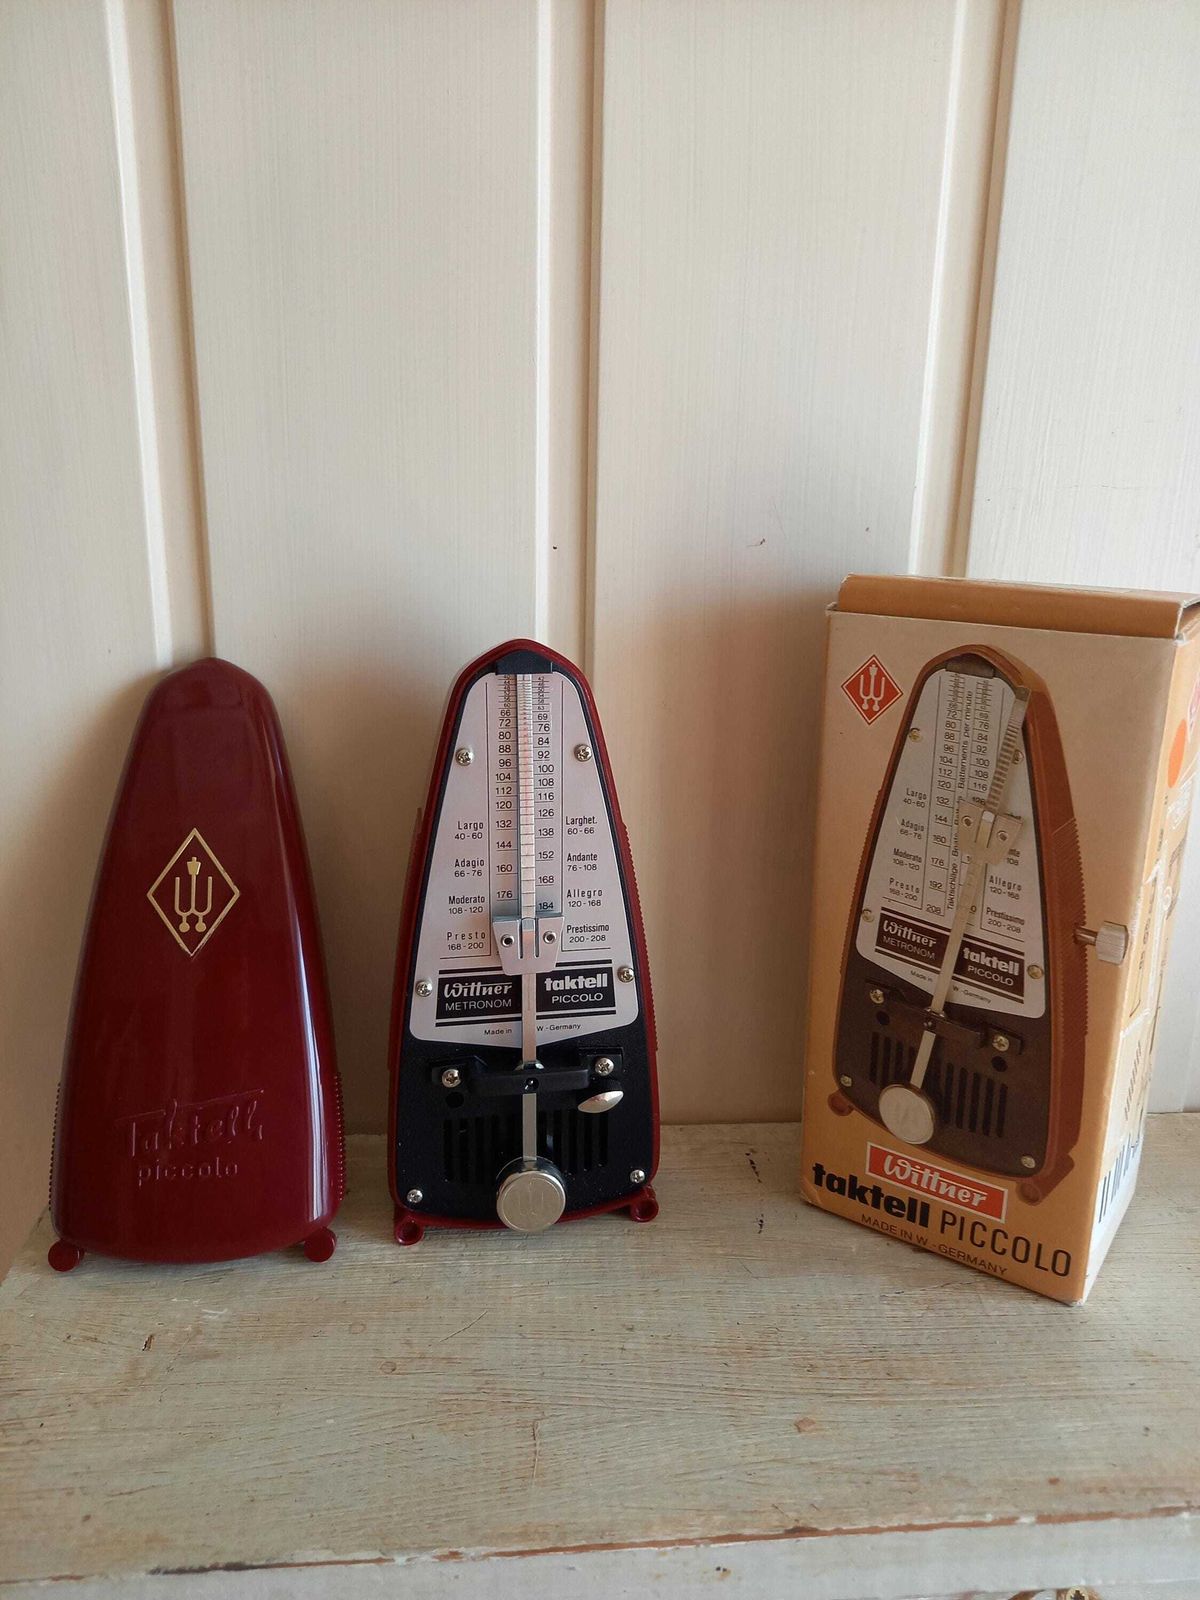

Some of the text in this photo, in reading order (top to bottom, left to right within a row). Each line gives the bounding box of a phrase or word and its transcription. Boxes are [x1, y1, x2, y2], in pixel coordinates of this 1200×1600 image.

[499, 719, 511, 727] 72
[538, 723, 550, 732] 76
[979, 721, 990, 730] 76
[498, 731, 512, 740] 80
[944, 732, 955, 740] 88
[958, 740, 968, 788] Battements
[965, 690, 973, 720] minute
[977, 733, 988, 742] 84
[537, 737, 550, 745] 84
[498, 745, 512, 753] 88
[943, 744, 954, 753] 96
[976, 745, 988, 754] 92
[537, 751, 550, 759] 92
[498, 759, 512, 767] 96
[939, 756, 953, 764] 104
[975, 757, 990, 767] 100
[538, 764, 554, 772] 100
[938, 768, 953, 776] 112
[495, 773, 512, 781] 104
[974, 769, 989, 779] 108
[538, 778, 554, 786] 108
[938, 780, 951, 789] 120
[495, 786, 512, 795] 112
[973, 782, 988, 792] 116
[538, 792, 554, 800] 116
[906, 788, 927, 800] Largo
[496, 801, 512, 809] 120
[936, 796, 950, 805] 132
[538, 809, 554, 817] 126
[565, 816, 598, 827] Larghet.
[934, 814, 948, 824] 144
[457, 821, 484, 831] Largo
[496, 820, 512, 828] 132
[901, 818, 924, 832] Adagio
[538, 828, 554, 836] 138
[933, 834, 947, 844] 160
[496, 841, 512, 849] 144
[538, 851, 554, 859] 152
[566, 852, 598, 862] Andante
[893, 848, 922, 863] Moderato
[454, 858, 484, 868] Adagio
[931, 857, 945, 866] 176
[496, 864, 513, 872] 160
[538, 875, 554, 884] 168
[989, 875, 1022, 891] Allegro
[889, 877, 920, 894] Presto
[929, 880, 943, 890] 192
[496, 890, 513, 898] 176
[566, 888, 603, 899] Allegro
[448, 895, 485, 905] Moderato
[538, 902, 554, 910] 184
[926, 904, 942, 915] 208
[566, 924, 610, 933] Prestissimo
[883, 919, 936, 947] Wittner
[447, 931, 486, 941] Presto
[883, 935, 936, 960] METRONOM
[963, 947, 1020, 976] taktell
[968, 965, 1014, 986] PICCOLO
[544, 974, 608, 992] taktell
[444, 981, 512, 998] Wittner
[552, 992, 603, 1004] PICCOLO
[445, 999, 512, 1011] METRONOM
[884, 1154, 988, 1207] Wittner
[812, 1162, 1072, 1277] taktell PICCOLO
[861, 1214, 897, 1235] MADE
[900, 1228, 913, 1240] IN
